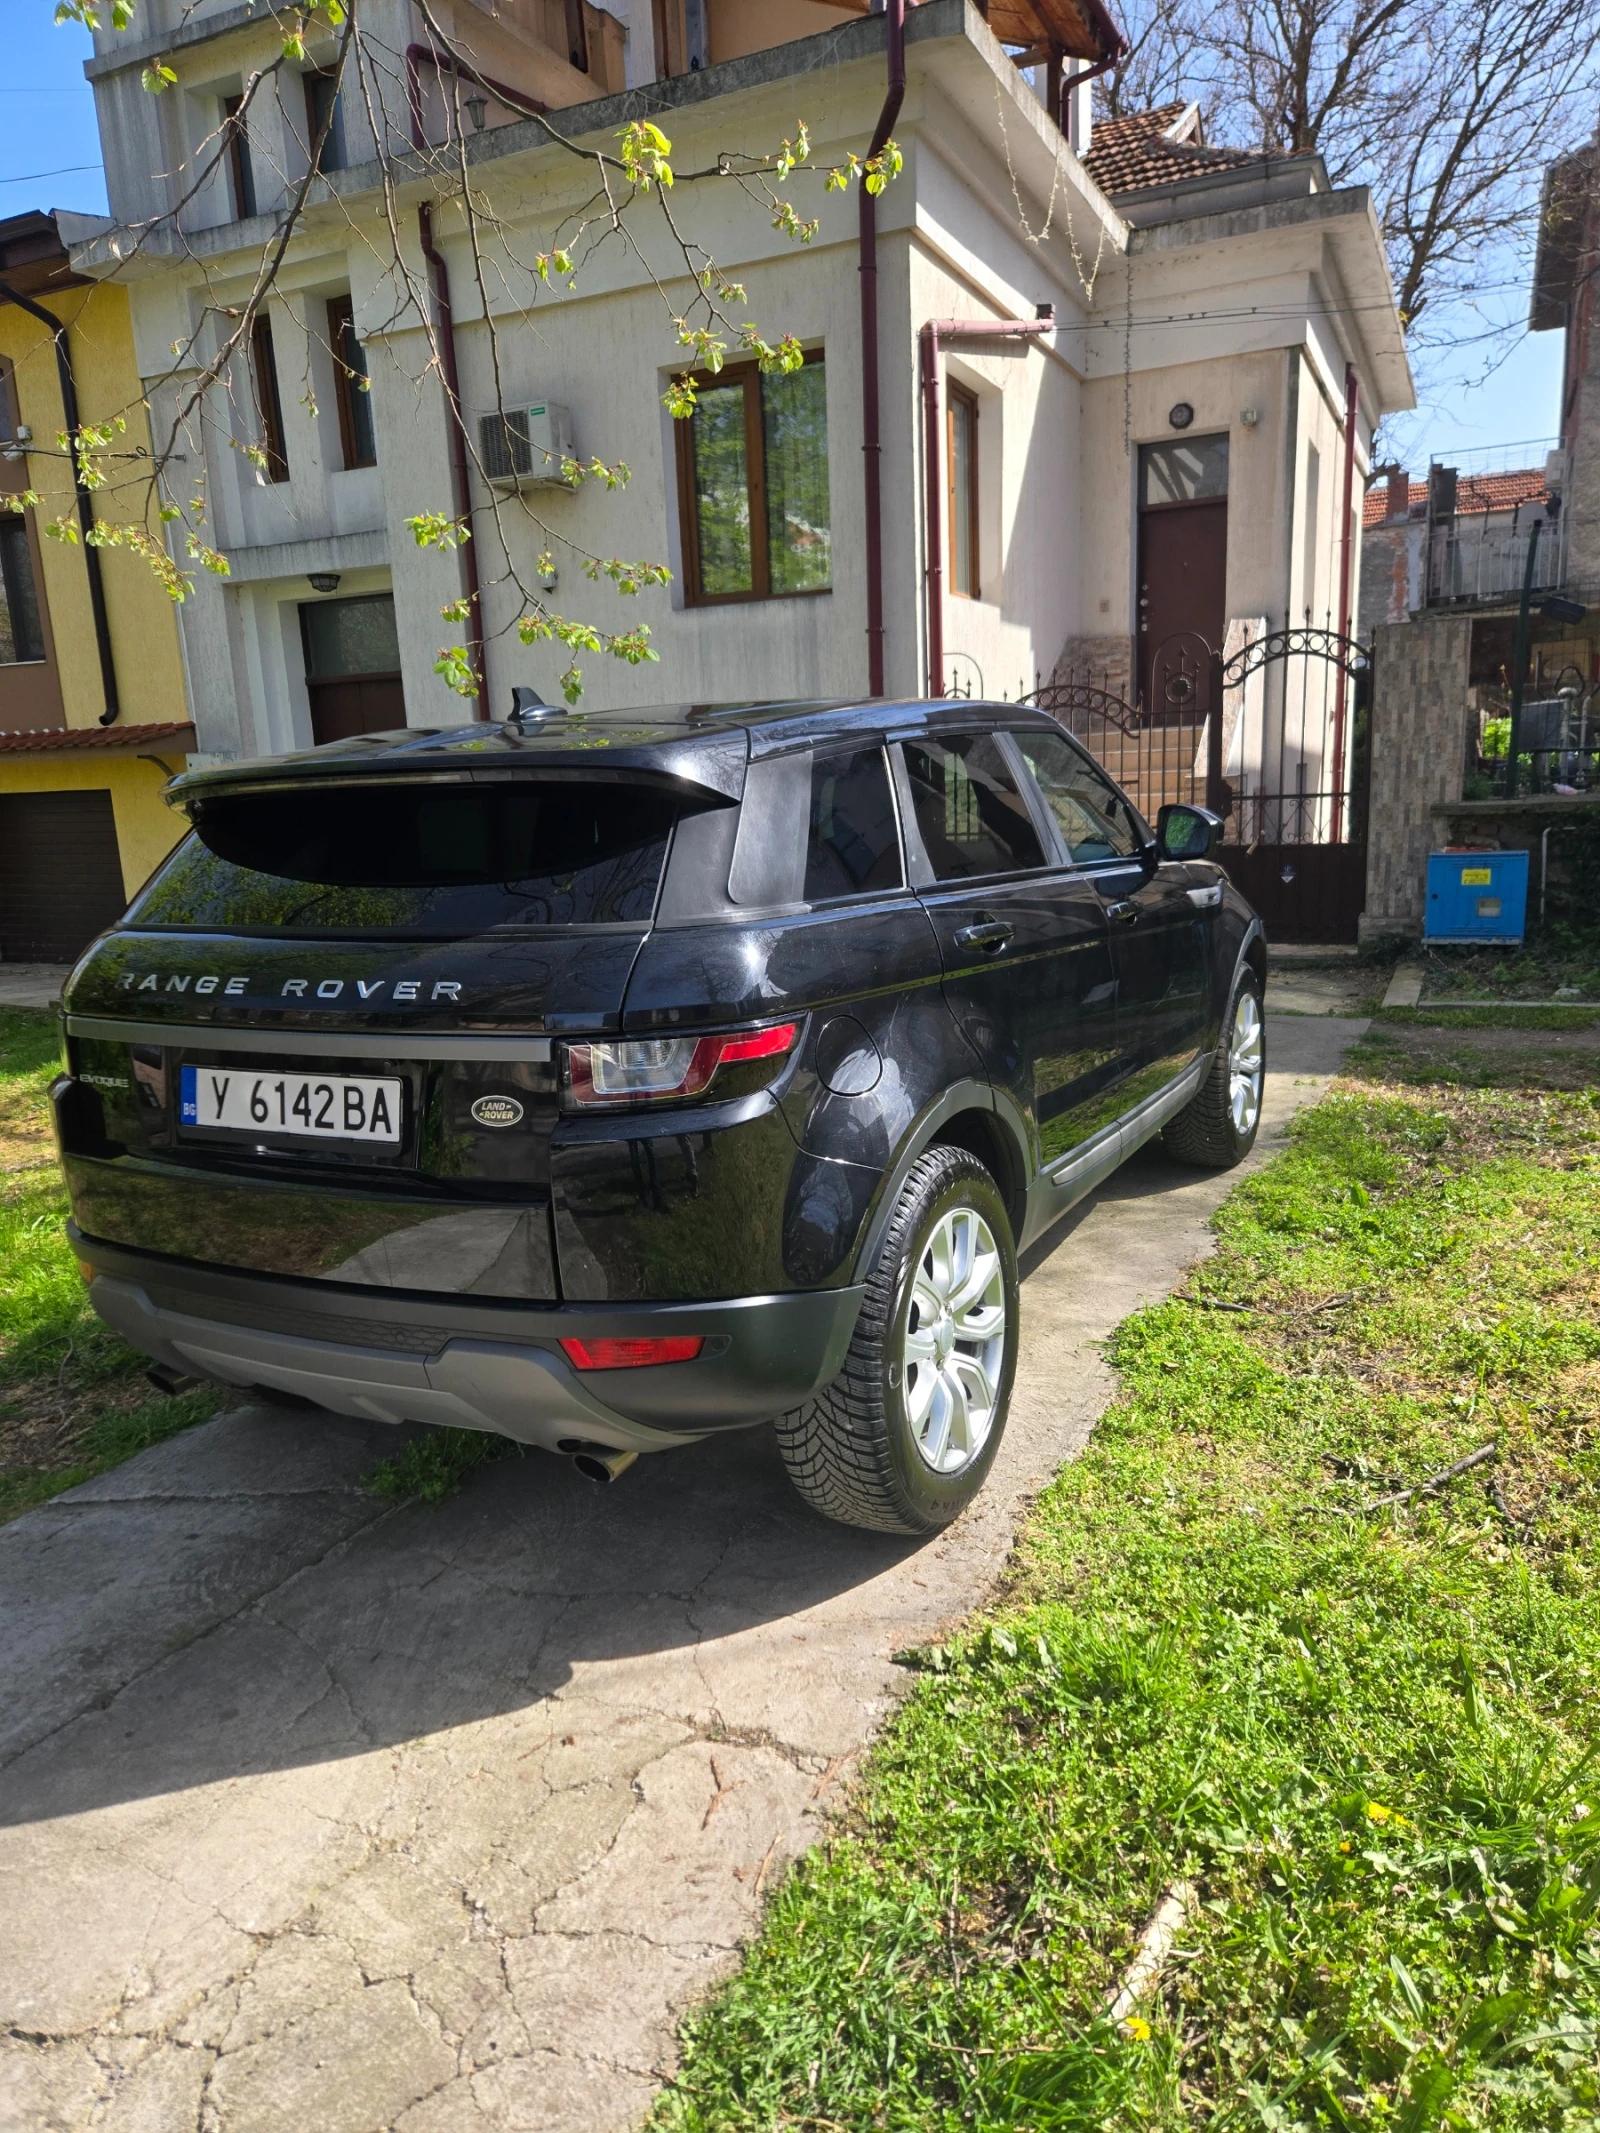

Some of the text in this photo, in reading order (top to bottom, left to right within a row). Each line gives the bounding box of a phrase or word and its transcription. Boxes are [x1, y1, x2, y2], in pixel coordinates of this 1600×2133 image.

[114, 972, 462, 1000] RANGE ROVER
[79, 1073, 130, 1088] EVOQUE
[183, 1103, 197, 1116] BG
[481, 1102, 506, 1111] LAND
[483, 1110, 514, 1119] ROVER
